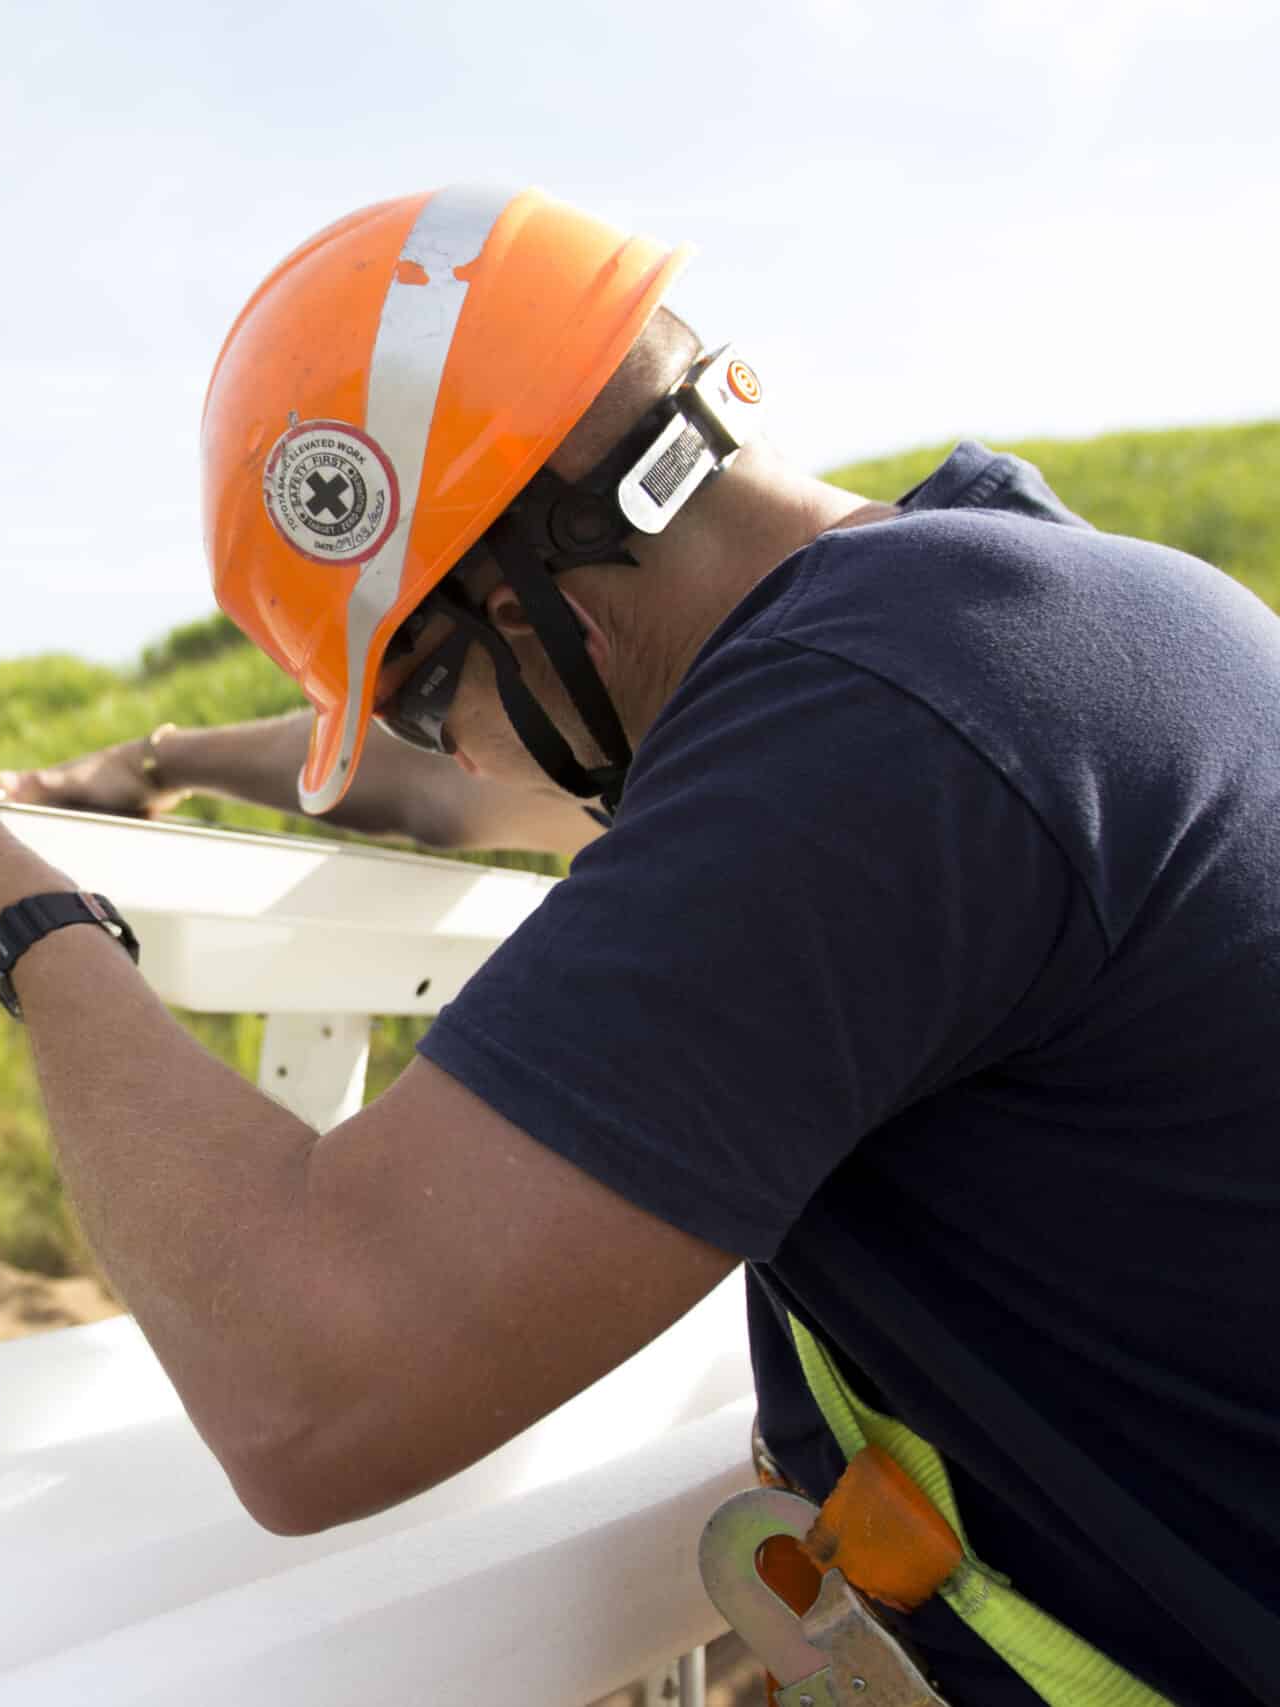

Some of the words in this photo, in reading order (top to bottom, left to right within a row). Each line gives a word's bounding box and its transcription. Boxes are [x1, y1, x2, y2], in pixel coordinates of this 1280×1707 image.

[278, 493, 299, 532] TOYOTA
[289, 438, 336, 462] ELEVATED
[337, 441, 367, 465] WORK
[290, 461, 308, 506] SAFETY
[311, 454, 346, 469] FIRST
